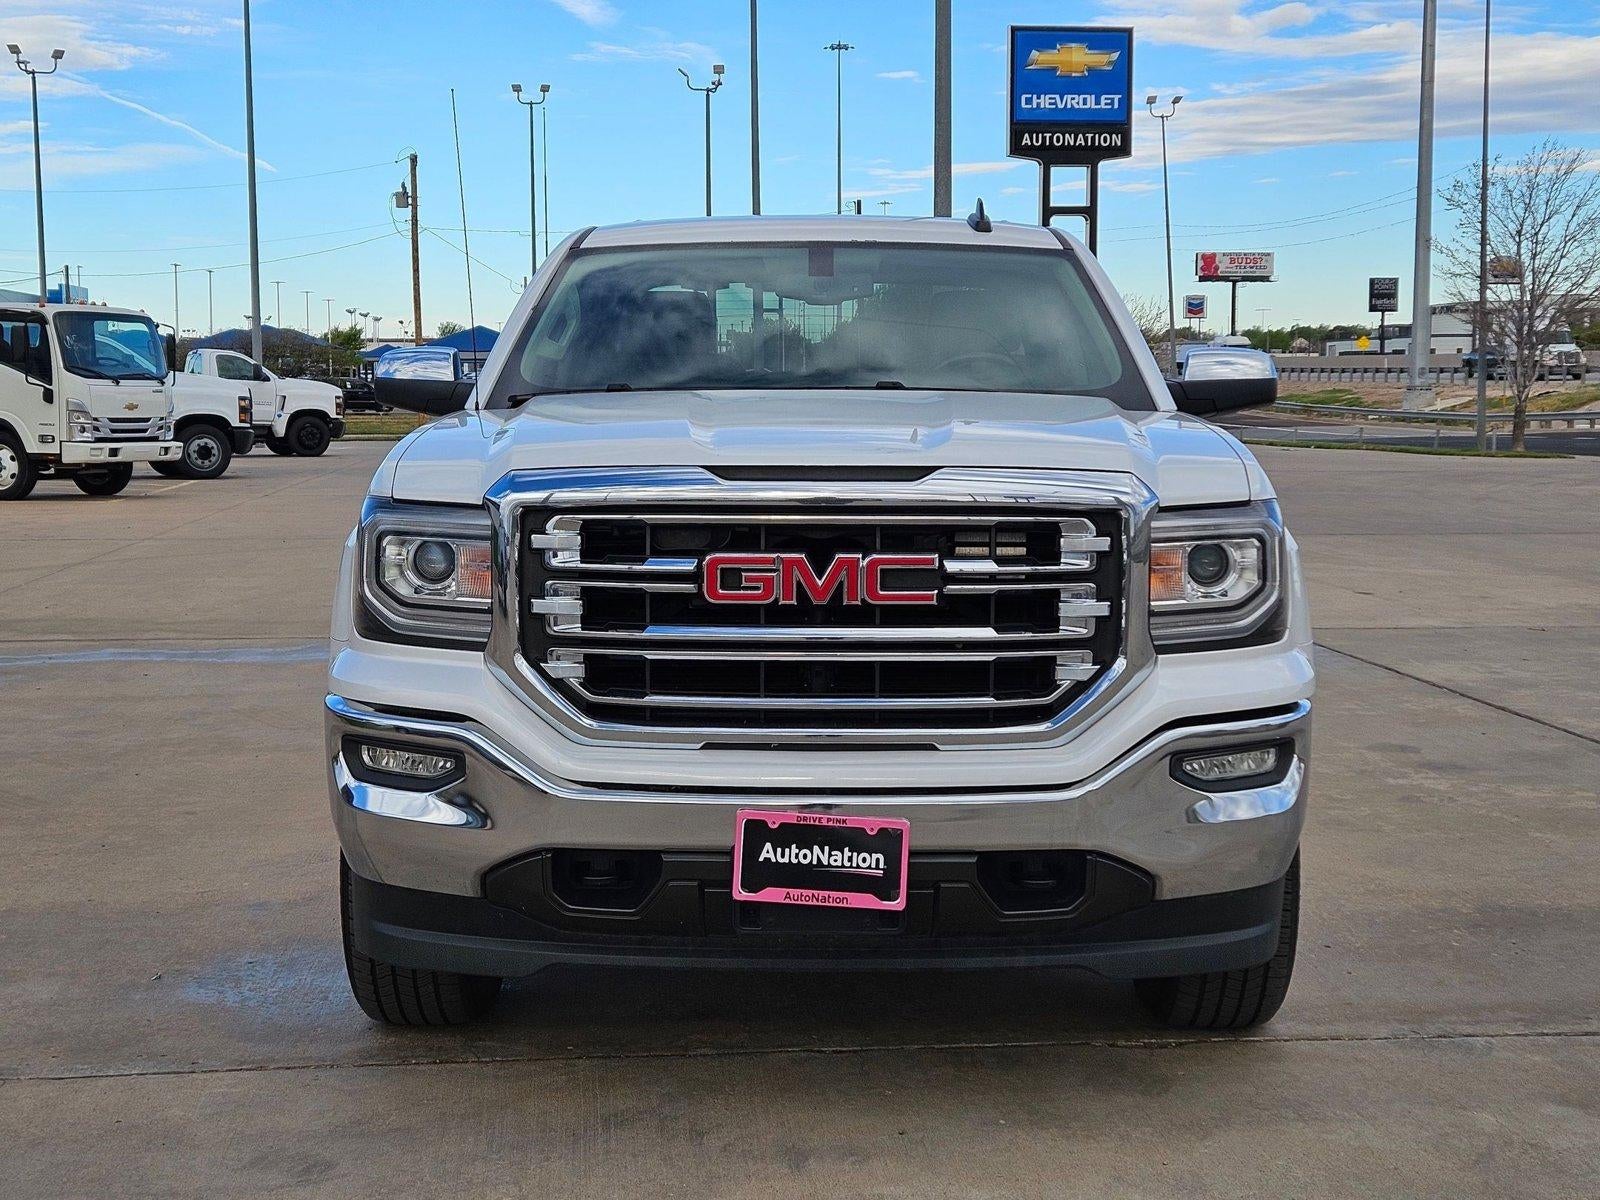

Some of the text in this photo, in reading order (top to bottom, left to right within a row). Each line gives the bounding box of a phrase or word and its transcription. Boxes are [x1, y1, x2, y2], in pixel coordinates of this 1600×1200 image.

[1021, 94, 1122, 109] CHEVROLET
[1021, 132, 1122, 147] AUTONATION
[1229, 257, 1264, 265] BUDS?
[703, 553, 939, 605] GMC
[796, 815, 848, 826] DRIVE PINK
[758, 842, 886, 869] AutoNation
[783, 891, 850, 905] AutoNation
